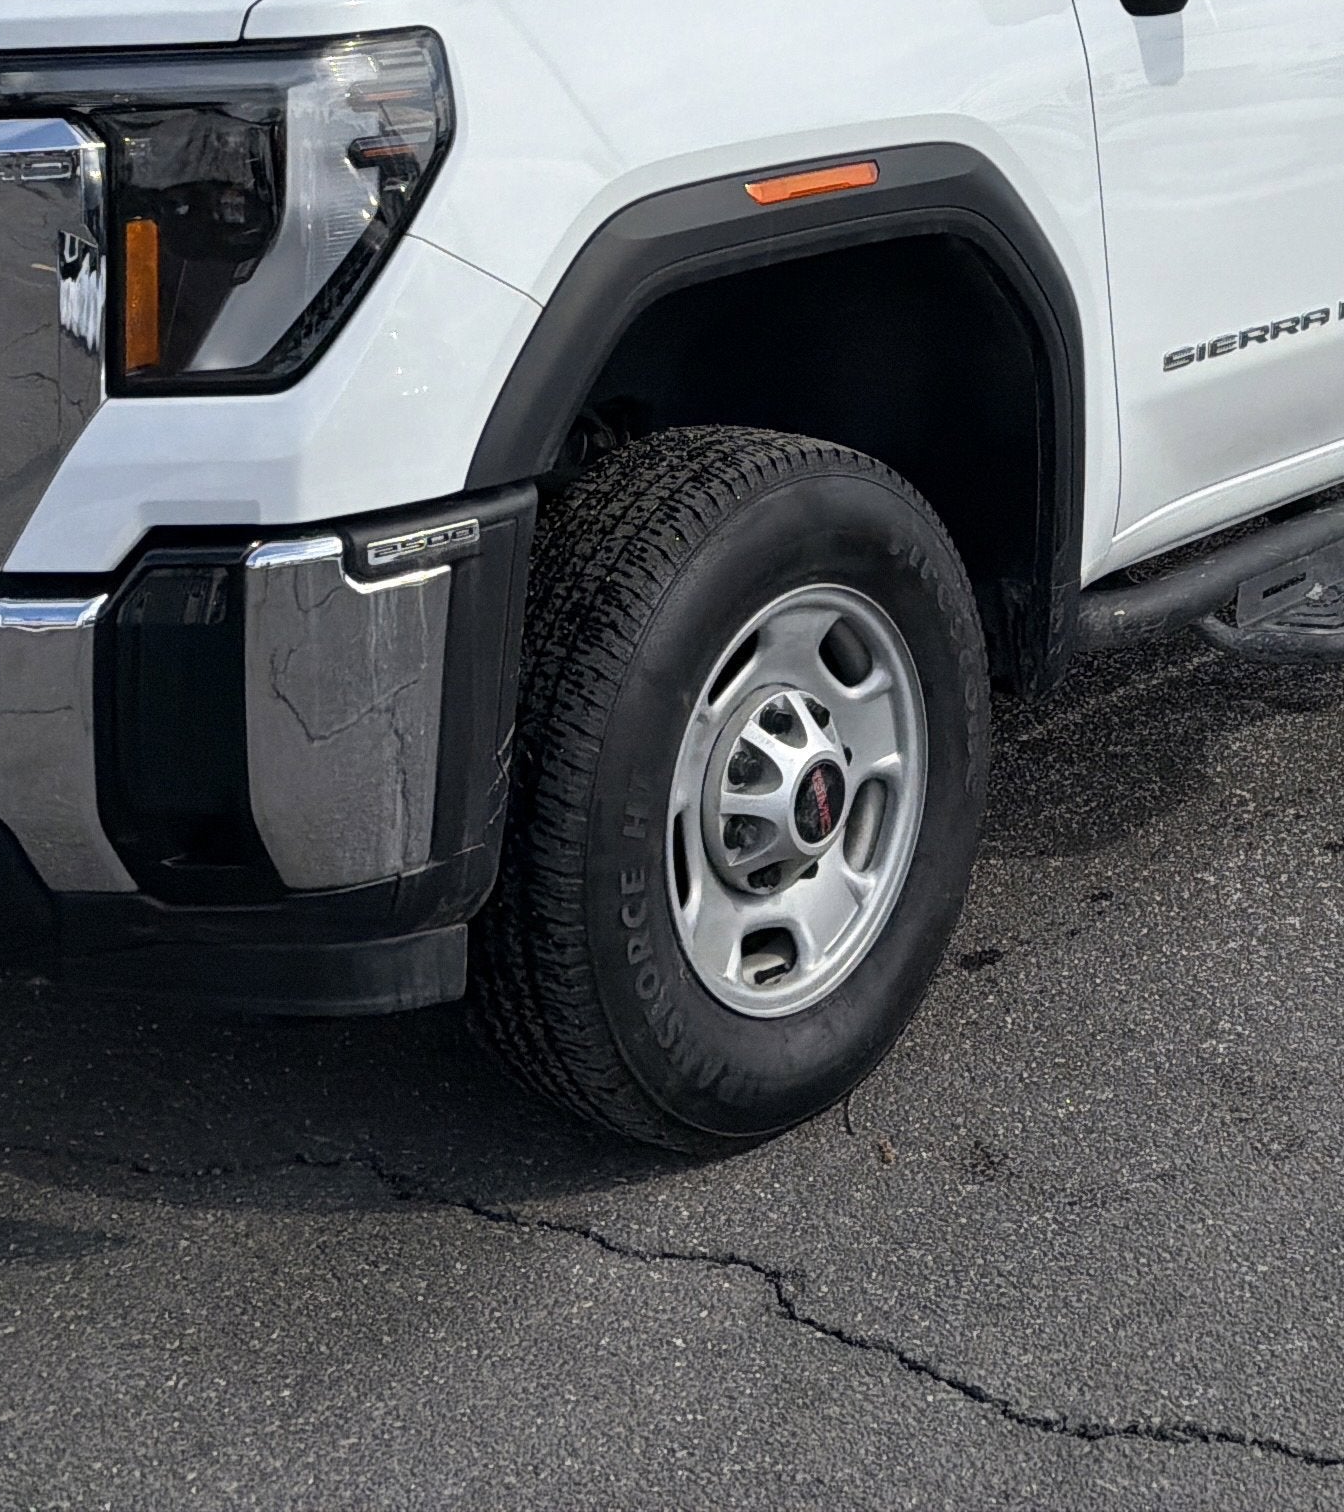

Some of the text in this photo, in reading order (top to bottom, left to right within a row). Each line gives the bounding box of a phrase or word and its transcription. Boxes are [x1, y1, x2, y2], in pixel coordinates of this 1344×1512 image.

[1162, 307, 1331, 372] SIERRA
[367, 518, 480, 565] 2500
[811, 767, 833, 837] GMC
